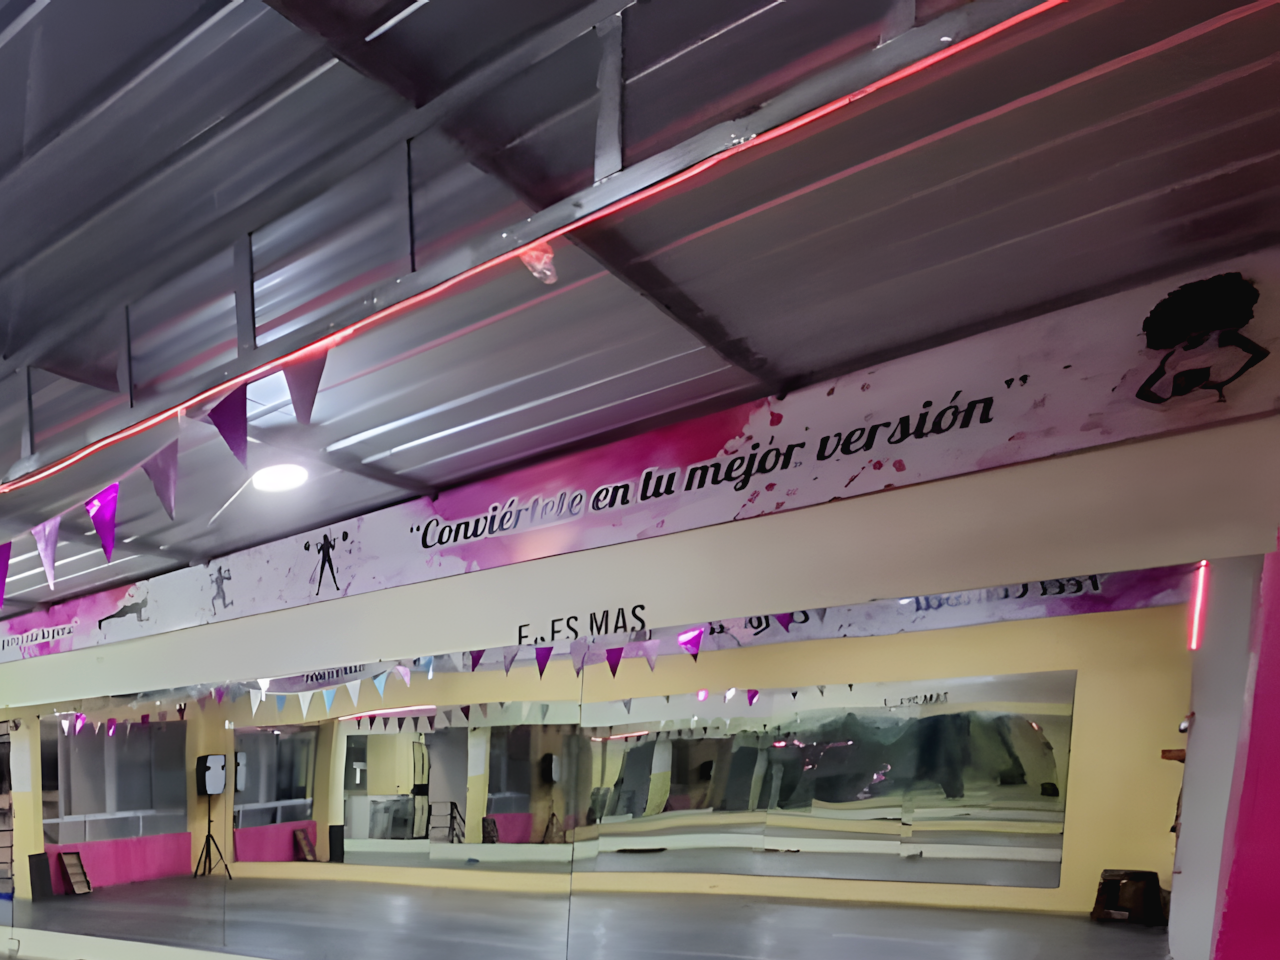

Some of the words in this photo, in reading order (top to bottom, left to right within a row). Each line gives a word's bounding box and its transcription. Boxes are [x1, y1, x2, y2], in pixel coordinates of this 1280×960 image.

[592, 482, 629, 511] en
[641, 471, 677, 501] tu
[684, 441, 805, 491] mejor
